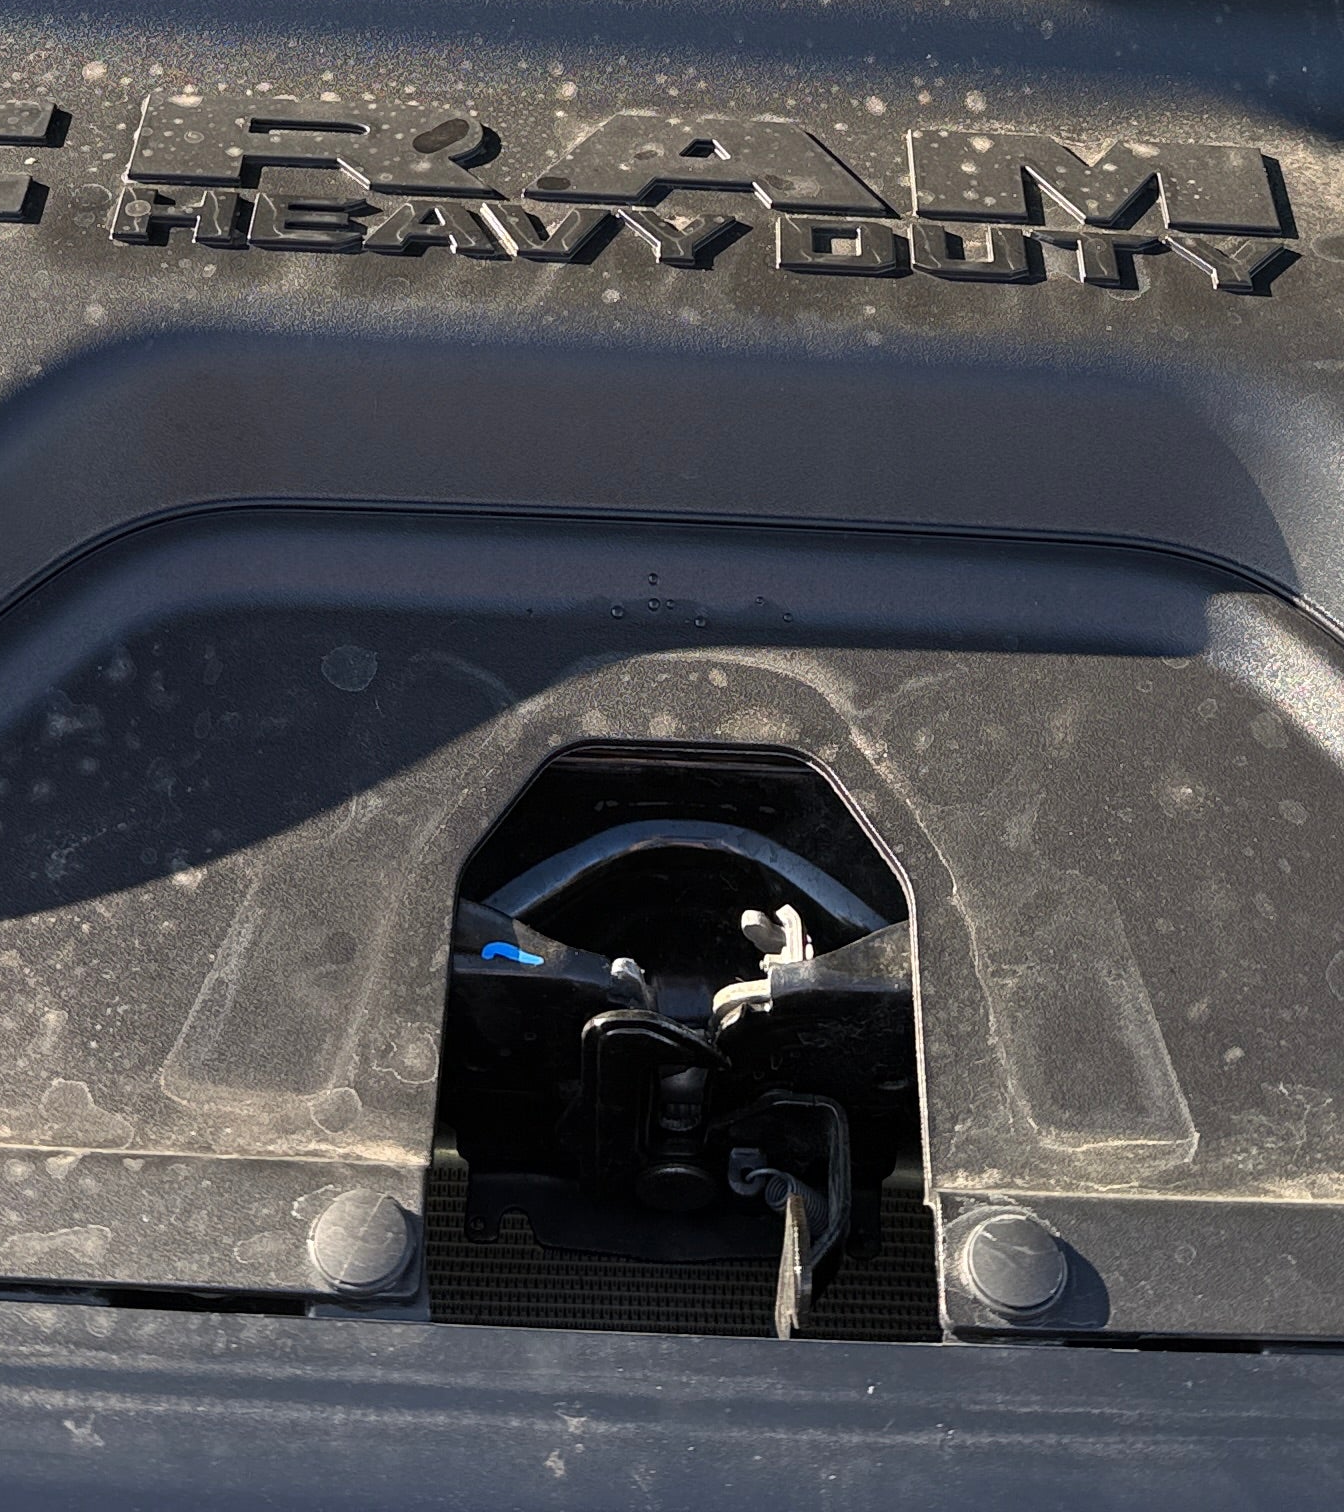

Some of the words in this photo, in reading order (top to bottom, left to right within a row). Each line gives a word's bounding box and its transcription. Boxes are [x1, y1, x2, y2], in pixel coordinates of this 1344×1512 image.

[124, 93, 1288, 236] RAM
[109, 185, 740, 269] HEAVY
[775, 214, 1290, 293] DUTY
